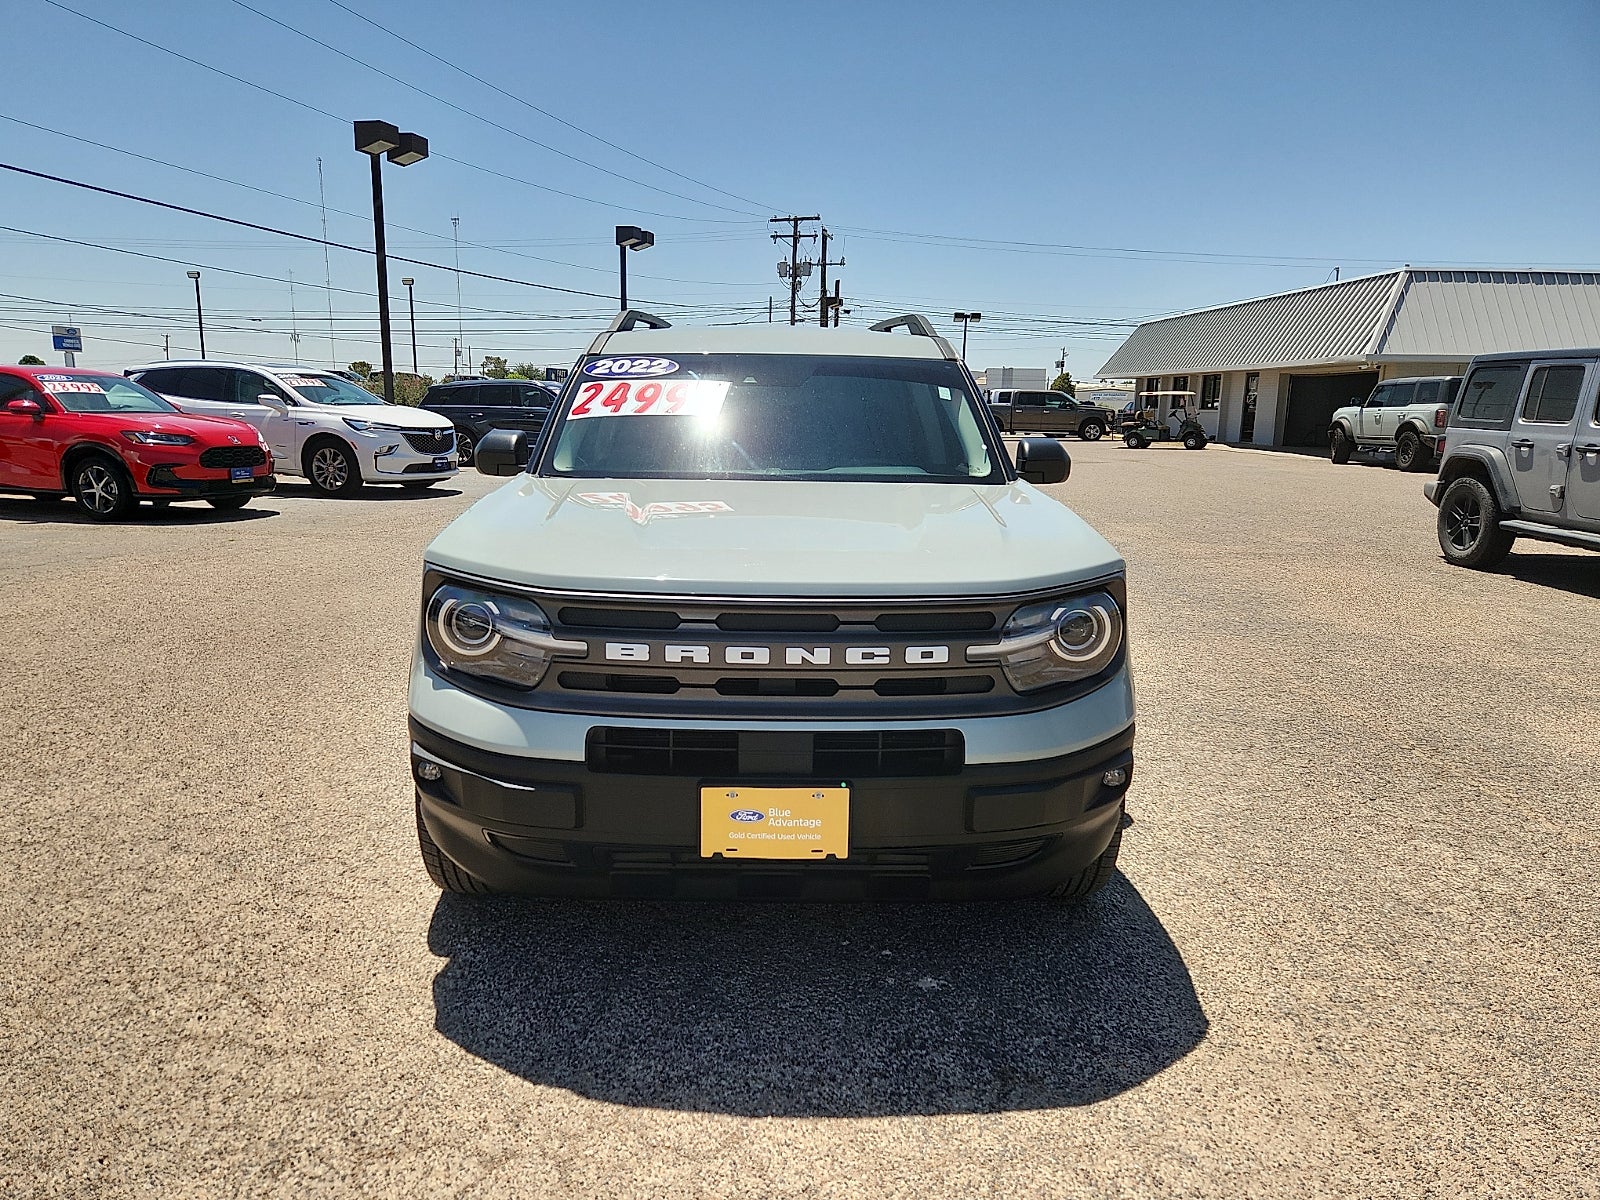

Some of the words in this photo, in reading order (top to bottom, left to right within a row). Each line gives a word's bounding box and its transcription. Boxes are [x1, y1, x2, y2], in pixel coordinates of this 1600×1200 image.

[591, 358, 671, 375] 2022
[47, 382, 102, 393] 28995
[571, 382, 712, 416] 2499
[605, 642, 949, 666] BRONCO
[735, 810, 759, 822] Ford
[768, 808, 791, 817] Blue
[768, 818, 822, 829] Advantage
[746, 832, 776, 840] Certified
